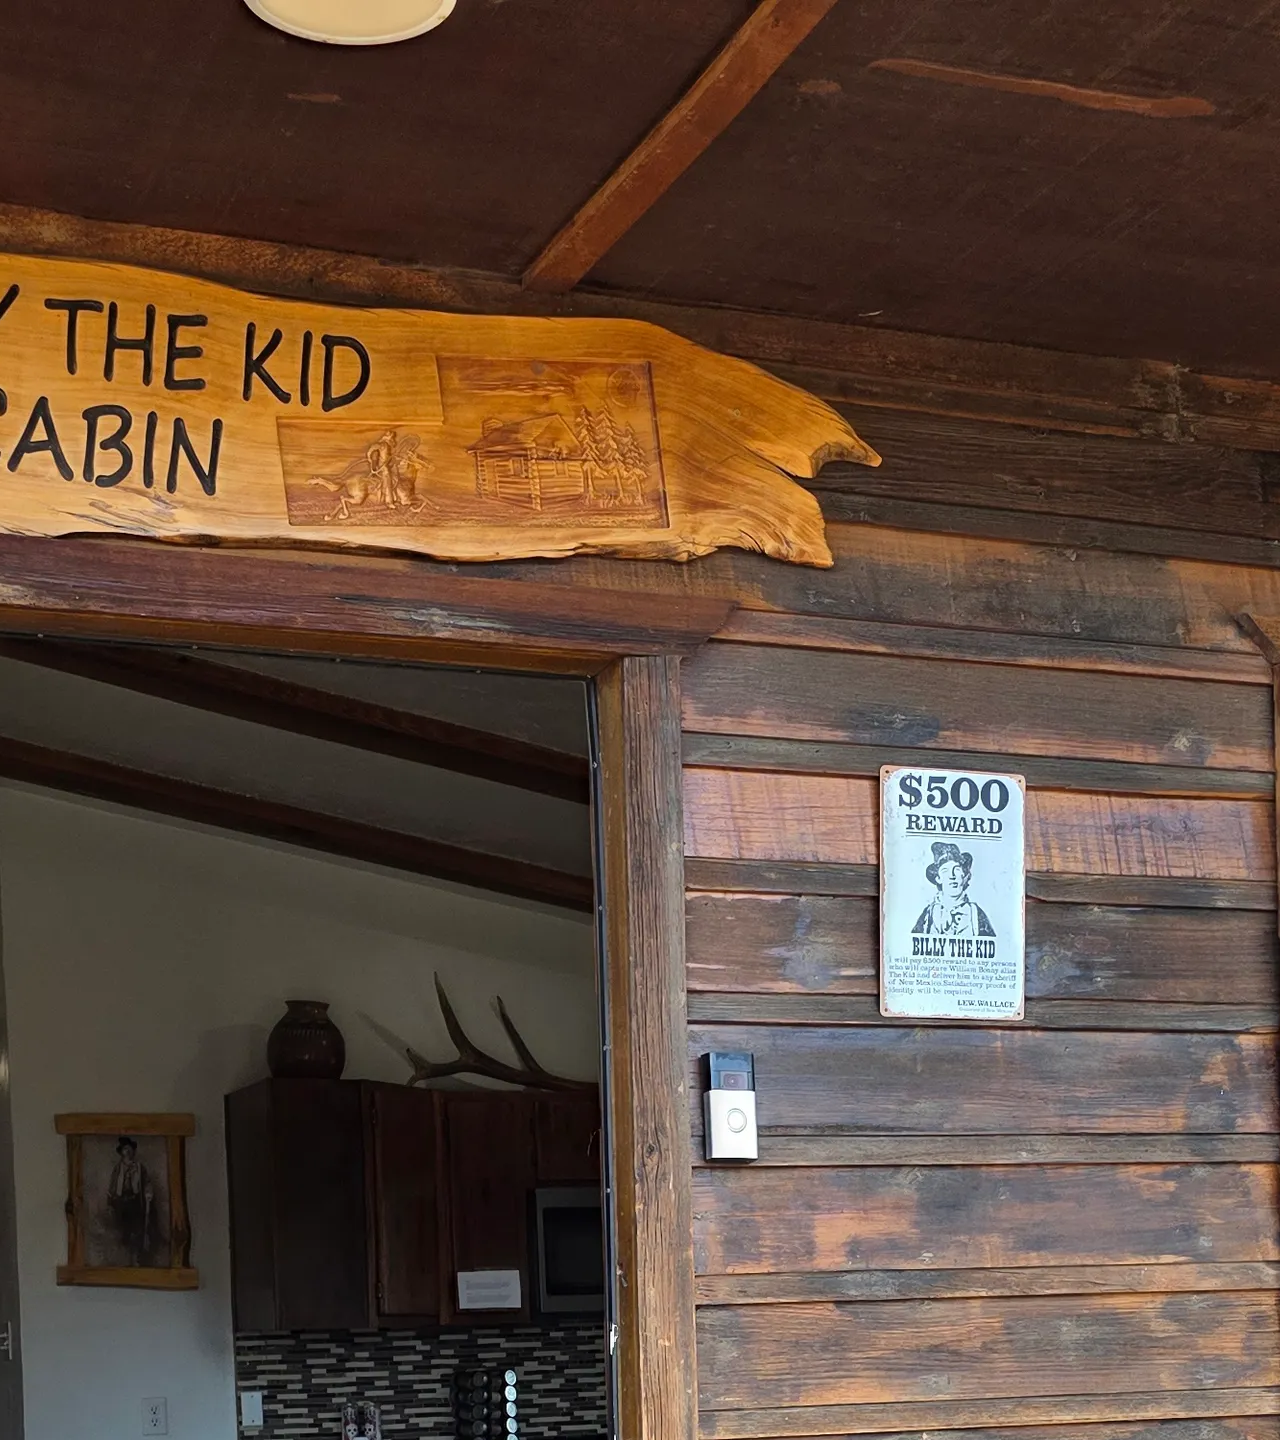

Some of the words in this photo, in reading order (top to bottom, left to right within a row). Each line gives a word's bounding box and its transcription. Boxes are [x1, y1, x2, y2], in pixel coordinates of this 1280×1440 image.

[42, 296, 210, 392] THE
[241, 320, 372, 414] KID
[898, 773, 1010, 813] $500
[906, 813, 1003, 834] REWARD
[912, 937, 947, 957] BILLY
[948, 938, 973, 958] THE
[975, 939, 996, 959] KID
[909, 958, 922, 966] pay
[920, 965, 948, 973] capture
[949, 965, 977, 973] William
[995, 974, 1017, 982] sheriff
[985, 982, 1007, 990] proofs
